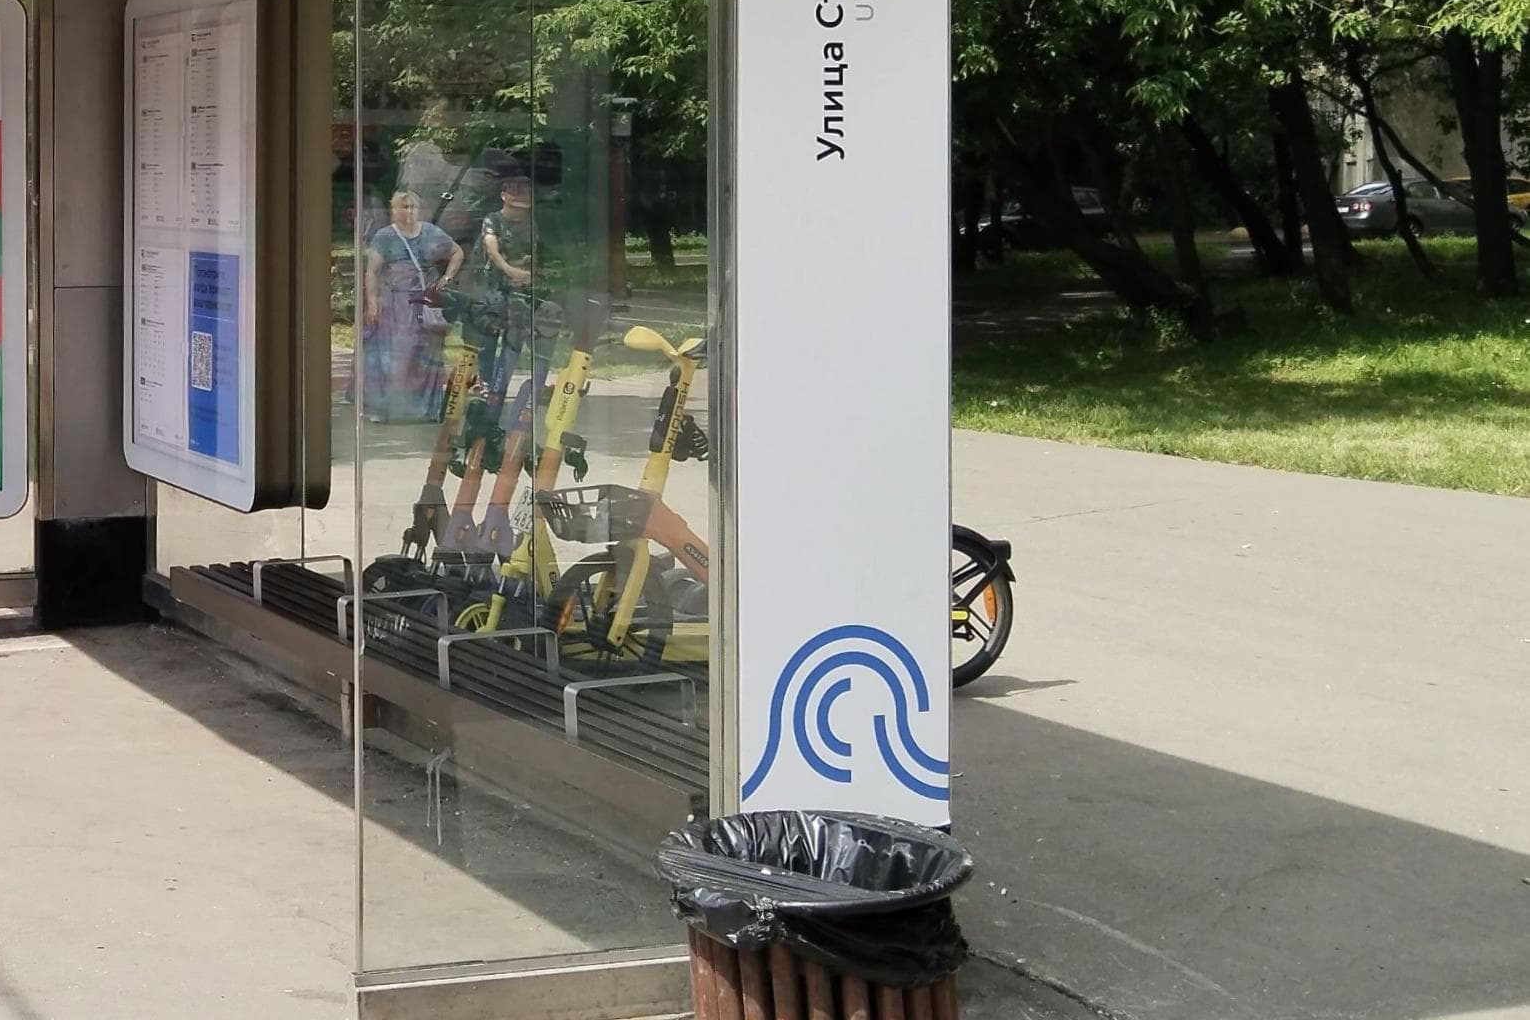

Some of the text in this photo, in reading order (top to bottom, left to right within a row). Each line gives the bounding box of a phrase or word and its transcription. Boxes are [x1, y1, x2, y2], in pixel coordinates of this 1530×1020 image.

[816, 41, 849, 161] Улица
[445, 354, 469, 416] WHOOSH
[664, 381, 690, 455] WHOOSH
